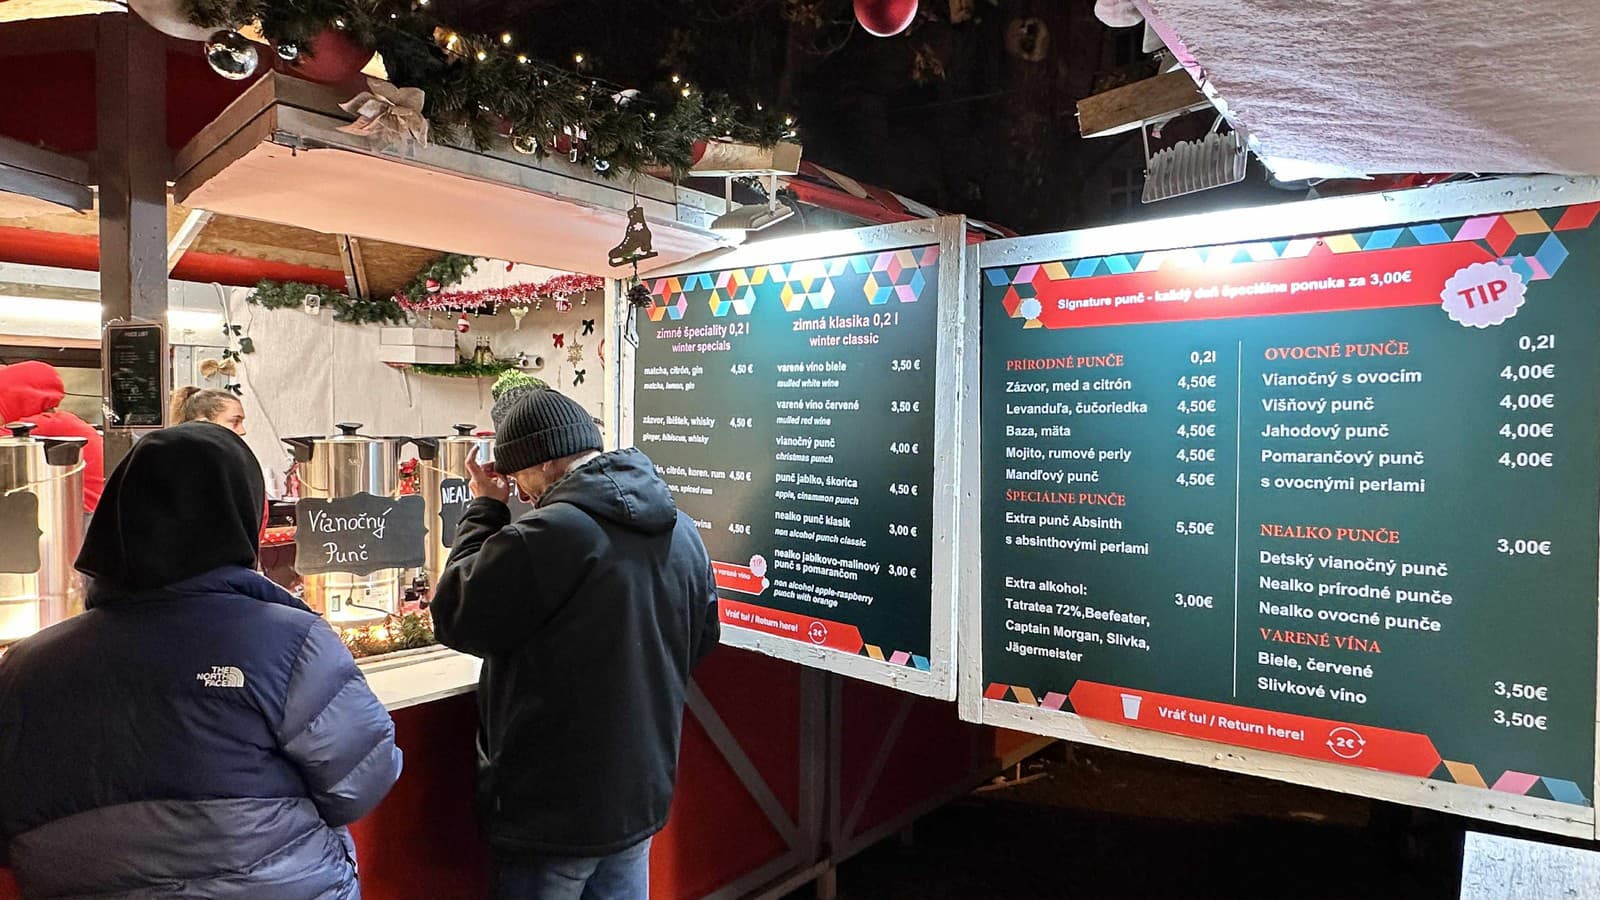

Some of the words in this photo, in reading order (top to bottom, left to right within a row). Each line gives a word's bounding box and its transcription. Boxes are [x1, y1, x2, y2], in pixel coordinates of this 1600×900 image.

[1058, 297, 1111, 310] Signature
[1115, 295, 1144, 308] punč
[1291, 278, 1345, 294] ponuka
[1349, 276, 1365, 288] za
[1370, 270, 1412, 287] 3,00€
[1458, 280, 1508, 309] TIP
[793, 316, 826, 331] zimná
[829, 315, 869, 329] klasika
[873, 313, 891, 327] 0,2
[656, 327, 681, 339] zimné
[684, 325, 727, 339] špeciality
[729, 323, 743, 336] 0,2
[672, 343, 696, 352] winter
[697, 341, 731, 353] specials
[810, 335, 840, 346] winter
[843, 333, 879, 345] classic
[1519, 334, 1555, 351] 0,2l
[1191, 351, 1216, 365] 0,2l
[1265, 342, 1340, 360] OVOCNÉ
[1345, 340, 1409, 357] PUNČE
[777, 363, 804, 372] varené
[806, 362, 824, 371] víno
[826, 361, 846, 371] biele
[891, 360, 912, 372] 3,50
[1077, 353, 1124, 367] PUNČE
[1263, 371, 1338, 388] Vianočný
[1357, 370, 1422, 384] ovocím
[1500, 365, 1555, 381] 4,00€
[1006, 380, 1050, 394] Zázvor,
[1053, 380, 1080, 391] med
[1093, 377, 1131, 390] citrón
[1178, 375, 1216, 389] 4,50€
[777, 400, 803, 409] varené
[805, 401, 823, 409] víno
[825, 400, 859, 410] červené
[891, 402, 910, 413] 3,50
[1006, 404, 1072, 416] Levanduľa,
[1076, 401, 1147, 413] čučoriedka
[1177, 400, 1216, 414] 4,50€
[1262, 398, 1326, 414] Višňový
[1332, 398, 1375, 413] punč
[1499, 394, 1554, 410] 4,00€
[691, 417, 715, 428] whisky
[730, 417, 745, 428] 4,50
[801, 416, 813, 425] red
[814, 417, 831, 425] wine
[1006, 426, 1037, 438] Baza,
[1041, 426, 1070, 436] mäta
[1177, 424, 1216, 438] 4,50€
[1261, 424, 1341, 440] Jahodový
[1345, 424, 1389, 440] punč
[1499, 423, 1554, 439] 4,00€
[776, 436, 812, 449] vianočný
[814, 437, 835, 449] punč
[890, 442, 910, 455] 4,00
[776, 454, 809, 463] christmas
[810, 455, 833, 464] punch
[1006, 447, 1045, 460] Mojito,
[1049, 448, 1095, 459] rumové
[1099, 448, 1131, 462] perly
[1177, 449, 1215, 462] 4,50€
[1261, 450, 1374, 467] Pomarančový
[1379, 451, 1424, 468] punč
[1498, 452, 1553, 468] 4,00€
[729, 471, 744, 480] 4,50
[775, 474, 795, 483] punč
[797, 474, 824, 486] jablko,
[826, 476, 858, 487] škorica
[1006, 469, 1065, 484] Mandľový
[1068, 470, 1099, 483] punč
[1176, 473, 1215, 487] 4,50€
[889, 483, 909, 496] 4,50
[1275, 477, 1354, 493] ovocnými
[1359, 478, 1425, 493] perlami
[775, 491, 795, 500] apple,
[835, 496, 859, 505] punch
[1006, 488, 1076, 504] ŠPECIÁLNE
[1079, 494, 1126, 506] PUNČE
[308, 507, 392, 539] Vianočný
[775, 511, 801, 522] nealko
[803, 514, 824, 525] punč
[826, 515, 850, 528] klasik
[1006, 512, 1036, 524] Extra
[1039, 515, 1069, 527] punč
[1072, 516, 1122, 529] Absinth
[728, 524, 744, 534] 4,50
[889, 524, 909, 536] 3,00
[1176, 521, 1214, 535] 5,50€
[1261, 524, 1332, 540] NEALKO
[1336, 529, 1399, 544] PUNČE
[789, 529, 815, 539] alcohol
[816, 534, 838, 544] punch
[840, 536, 866, 547] classic
[1015, 535, 1096, 552] absinthovými
[1100, 542, 1149, 554] perlami
[323, 543, 369, 564] Punč
[1497, 539, 1551, 556] 3,00€
[774, 550, 801, 560] nealko
[802, 551, 880, 575] jablkovo-malinový
[775, 559, 794, 569] punč
[803, 565, 858, 581] pomarančom
[1260, 551, 1314, 570] Detský
[1319, 556, 1396, 576] vianočný
[1401, 561, 1448, 578] punč
[888, 565, 908, 577] 3,00
[789, 582, 814, 592] alcohol
[815, 586, 873, 605] apple-raspberry
[1006, 576, 1036, 590] Extra
[1039, 580, 1087, 596] alkohol:
[1259, 576, 1314, 593] Nealko
[1318, 583, 1391, 600] prírodné
[1396, 590, 1452, 606] punče
[773, 589, 795, 599] punch
[797, 593, 811, 602] with
[813, 597, 838, 608] orange
[1006, 598, 1053, 614] Tatratea
[1175, 594, 1213, 608] 3,00€
[1259, 602, 1313, 619] Nealko
[1318, 608, 1380, 626] ovocné
[1385, 615, 1441, 632] punče
[1006, 619, 1050, 635] Captain
[1053, 625, 1103, 644] Morgan,
[1107, 633, 1150, 650] Slivka,
[1260, 628, 1330, 648] VARENÉ
[1335, 635, 1381, 653] VÍNA
[1005, 642, 1083, 662] Jägermeister
[1258, 652, 1302, 671] Biele,
[1306, 657, 1373, 679] červené
[1258, 678, 1326, 698] Slivkové
[1330, 687, 1367, 704] víno
[1494, 681, 1548, 702] 3,50€
[1158, 706, 1186, 722] Vráť
[1189, 711, 1207, 725] tu!
[1218, 716, 1264, 734] Return
[1268, 724, 1304, 741] here!
[1494, 710, 1548, 730] 3,50€
[1336, 737, 1354, 750] 2€
